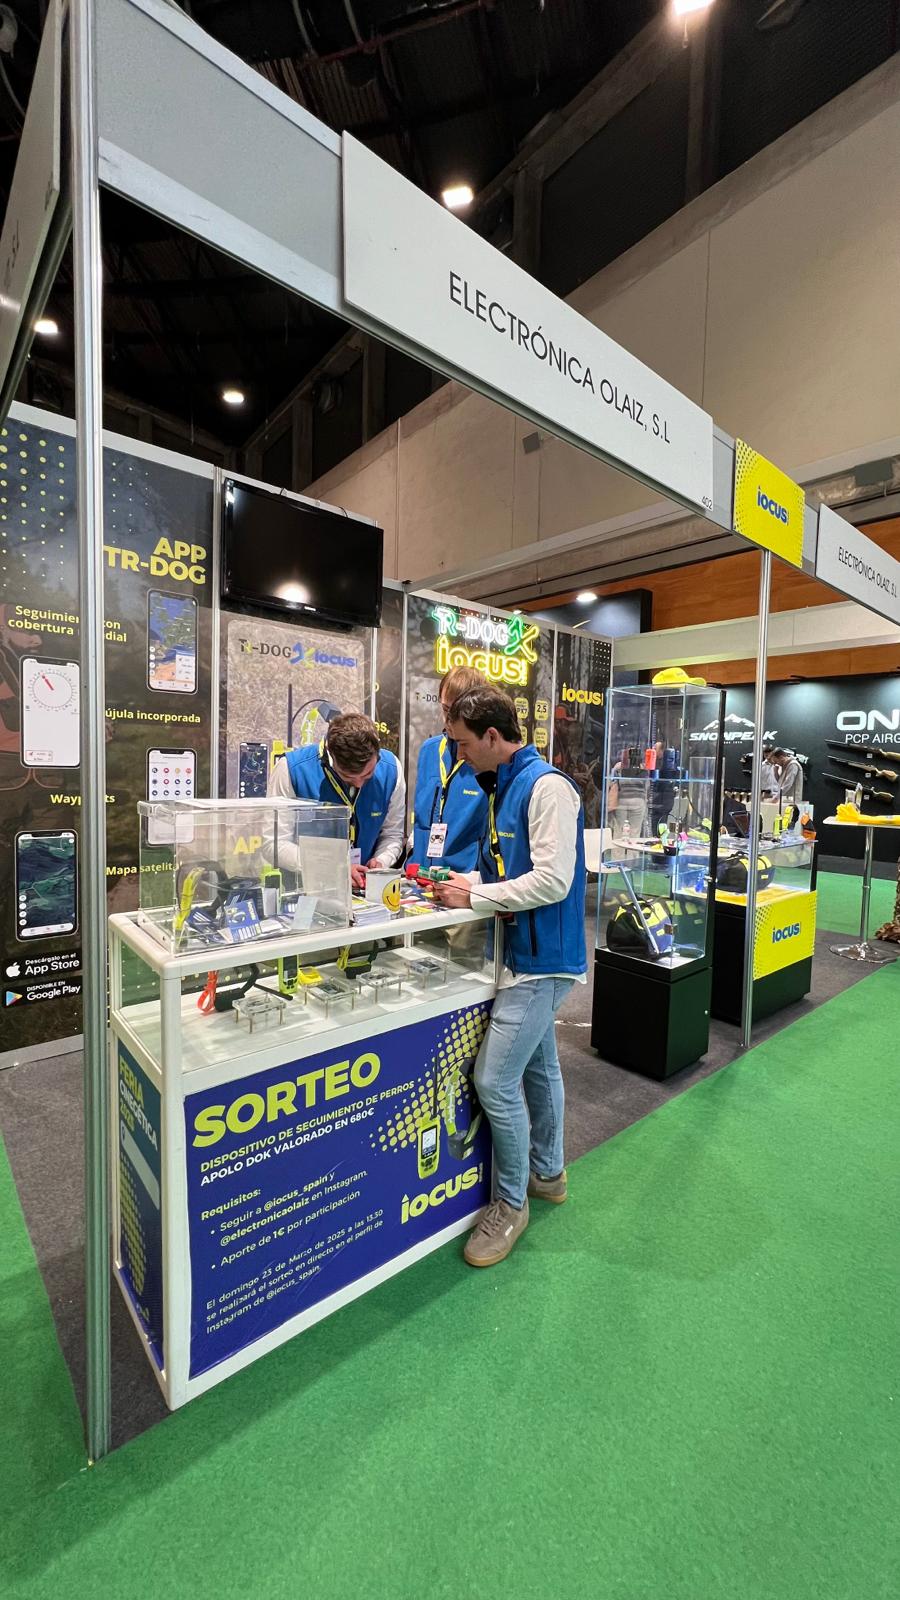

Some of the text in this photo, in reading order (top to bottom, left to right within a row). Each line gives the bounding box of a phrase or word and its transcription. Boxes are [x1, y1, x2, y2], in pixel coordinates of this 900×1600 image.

[450, 271, 595, 394] ELECTRÓNICA
[600, 379, 648, 431] OLAIZ,
[702, 496, 712, 509] 402
[103, 545, 205, 584] TR-DOG
[153, 537, 206, 563] APP
[838, 546, 875, 583] ELECTRÓNICA
[8, 617, 74, 636] cobertura
[105, 708, 201, 723] újula incorporada
[845, 734, 869, 744] PCP
[105, 866, 138, 876] Mapa
[25, 955, 60, 965] Descárgalo
[25, 960, 80, 976] App Store
[27, 981, 57, 992] DISPONIBLE
[27, 985, 81, 1001] Google Play
[192, 1052, 381, 1148] SORTEO
[200, 1081, 415, 1172] DISPOSITIVO DE SEGUIMIENTO DE PERROS
[200, 1107, 374, 1187] APOLO DOK VALORADO EN 680€
[201, 1189, 261, 1221] Requisitos:
[220, 1172, 335, 1231] Seguir a @iocus_spain y
[220, 1197, 310, 1247] @electronicaolaiz
[311, 1190, 323, 1200] en
[220, 1190, 361, 1267] Aporte de 1€ por participación
[206, 1299, 216, 1310] El
[219, 1277, 259, 1303] domingo
[275, 1262, 286, 1272] de
[289, 1247, 312, 1265] Marzo
[315, 1240, 325, 1250] de
[327, 1228, 345, 1244] 2025
[354, 1221, 364, 1229] las
[206, 1220, 383, 1322] se realizará el sorteo en directo en el perfil de
[206, 1304, 252, 1334] Instagram
[253, 1296, 265, 1306] de
